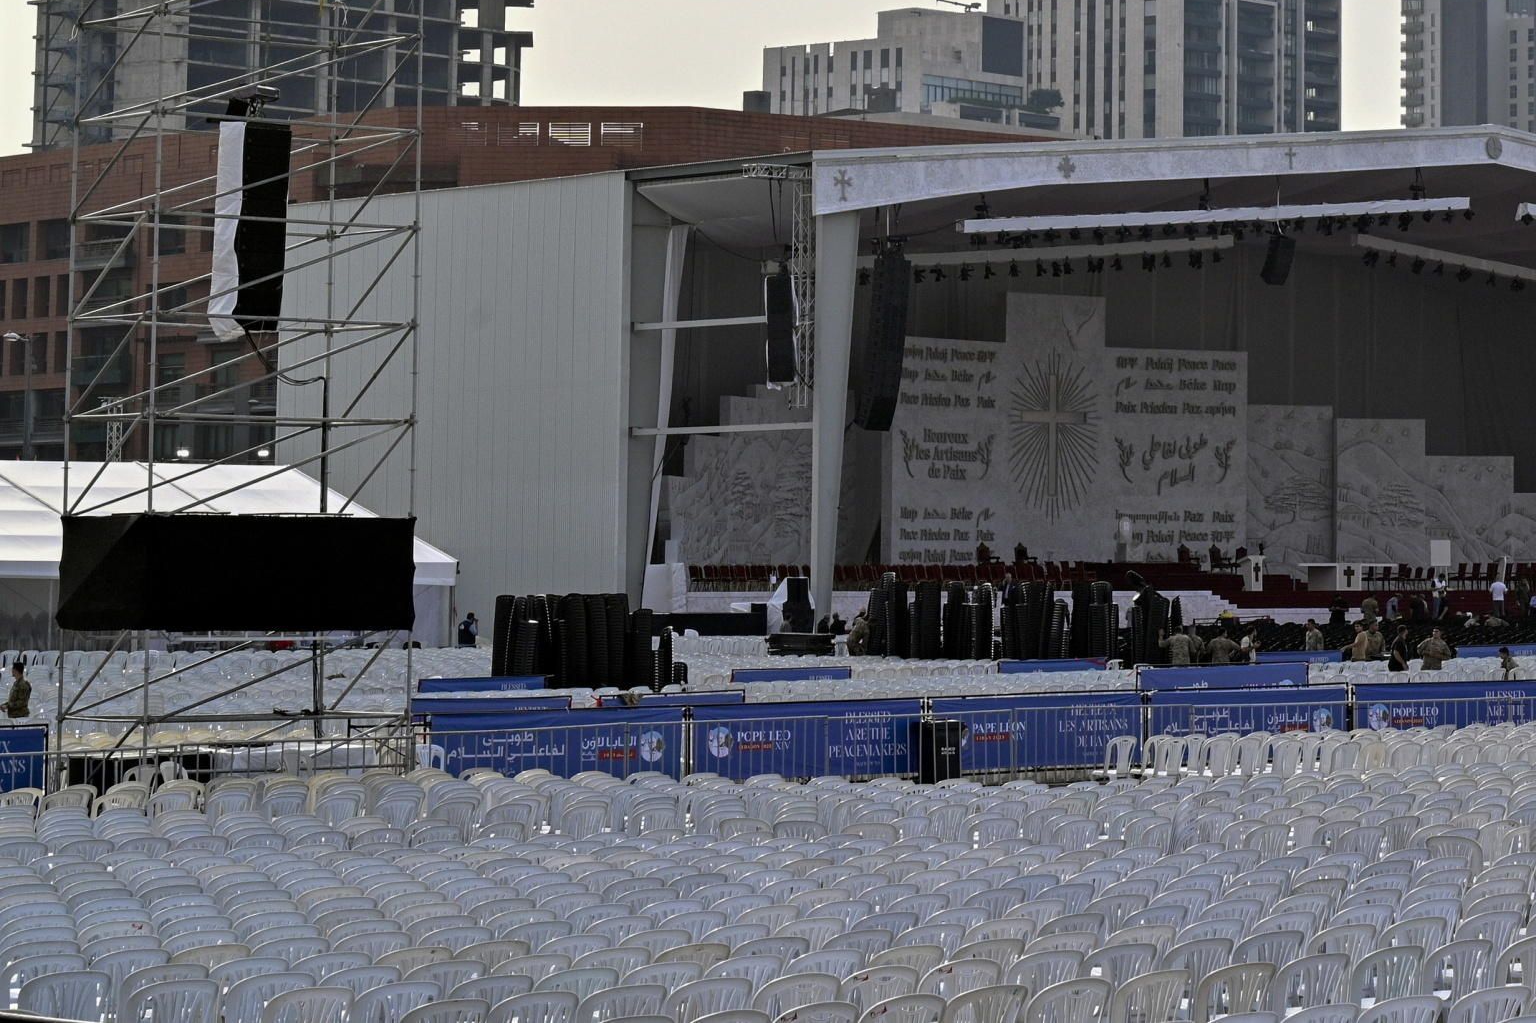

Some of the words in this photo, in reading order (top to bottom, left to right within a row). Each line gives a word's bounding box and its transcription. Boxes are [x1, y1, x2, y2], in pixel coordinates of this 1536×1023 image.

[923, 428, 969, 444] Heureux
[915, 444, 931, 461] les
[932, 445, 978, 462] Artisans
[928, 463, 940, 479] de
[943, 464, 967, 480] Paix
[1178, 529, 1208, 543] Peace
[1393, 707, 1418, 717] POPE
[483, 731, 533, 746] طوبى
[737, 730, 765, 742] POPE
[769, 729, 791, 741] LEO
[845, 727, 867, 741] ARE
[447, 746, 503, 765] السلام
[507, 744, 565, 763] لفاعلي
[829, 743, 907, 758] PEACEMAKERS
